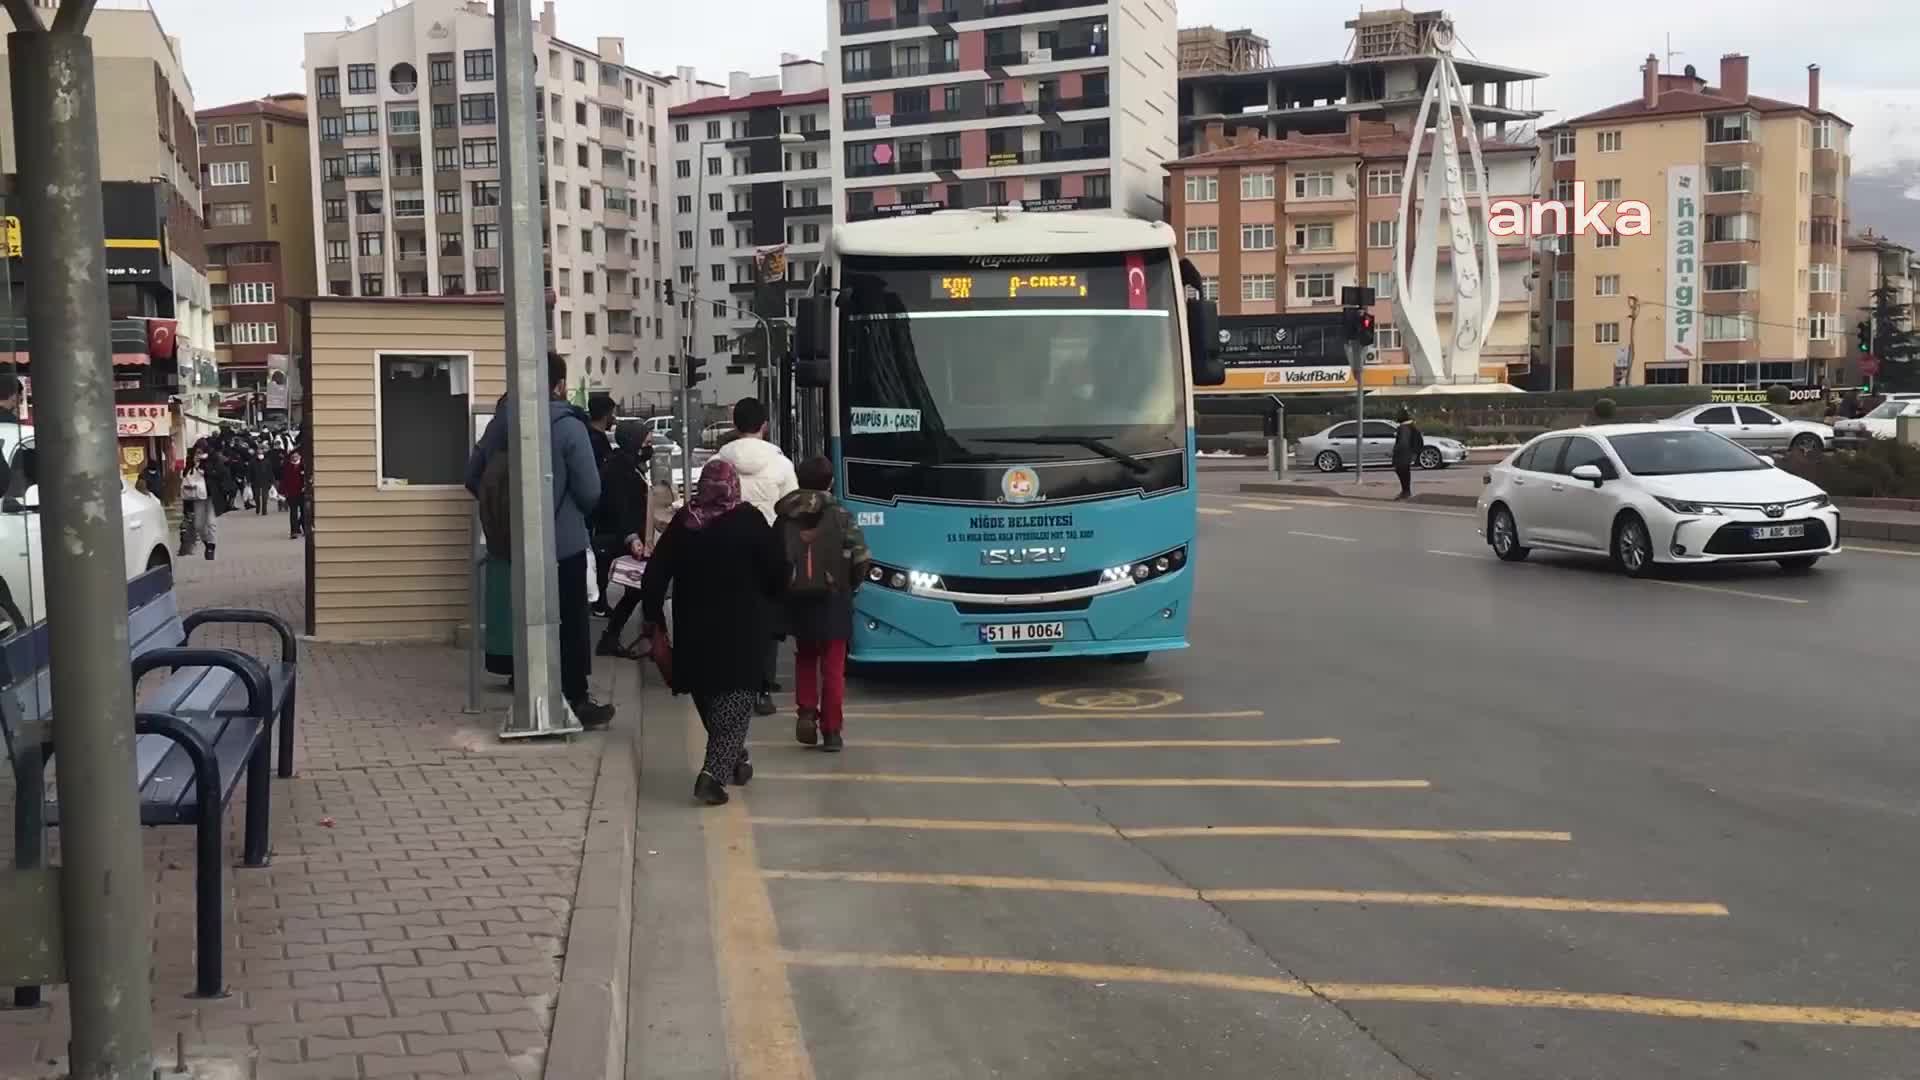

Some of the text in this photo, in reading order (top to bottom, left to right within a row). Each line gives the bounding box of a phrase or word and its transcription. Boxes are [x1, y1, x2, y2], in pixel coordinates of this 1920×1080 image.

[970, 513, 1072, 528] NİĞDE BELEDİYESİ
[980, 547, 1066, 565] ISUZU
[988, 623, 1061, 640] 51 H 0064
